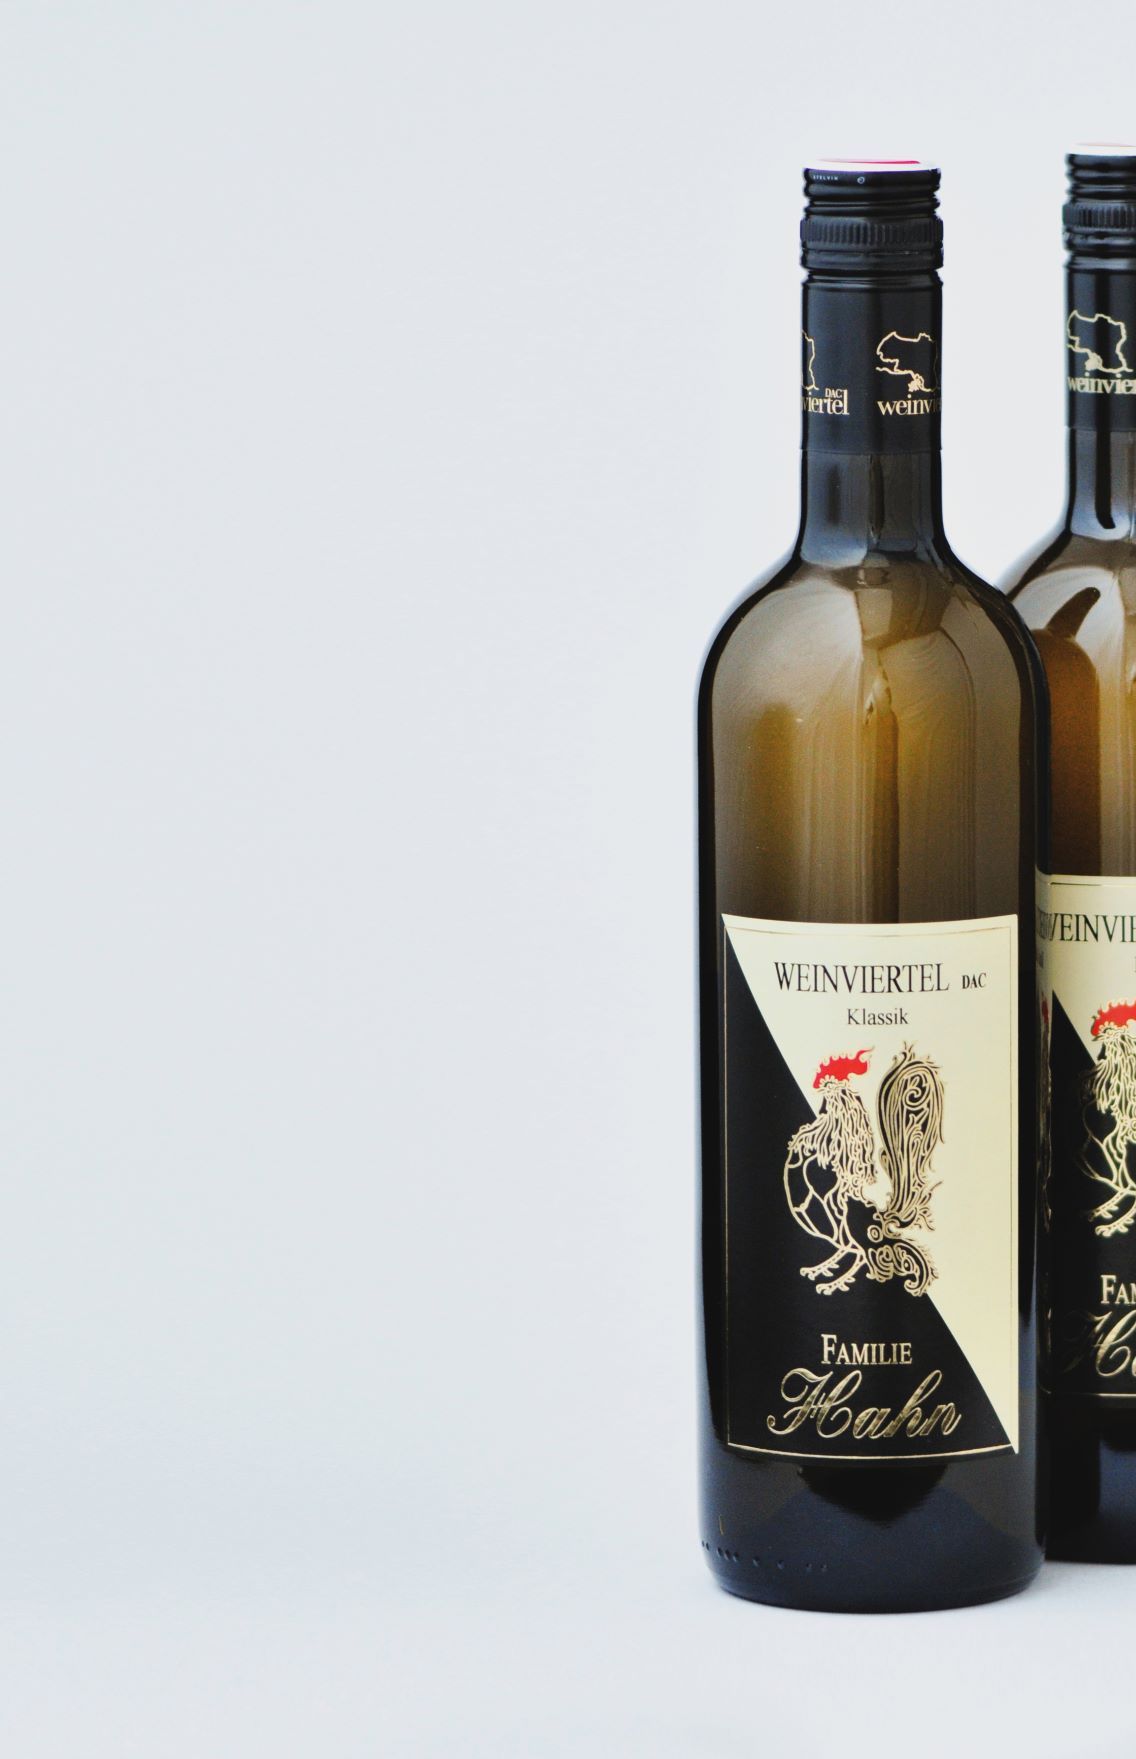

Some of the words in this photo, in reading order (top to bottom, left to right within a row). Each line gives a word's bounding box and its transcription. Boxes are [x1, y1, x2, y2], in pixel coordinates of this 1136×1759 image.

[825, 388, 842, 398] DAC
[774, 961, 950, 993] WEINVIERTEL
[961, 972, 987, 989] DAC
[847, 1007, 909, 1026] Klassik
[820, 1333, 913, 1366] FAMILIE
[766, 1367, 963, 1440] Hahn
